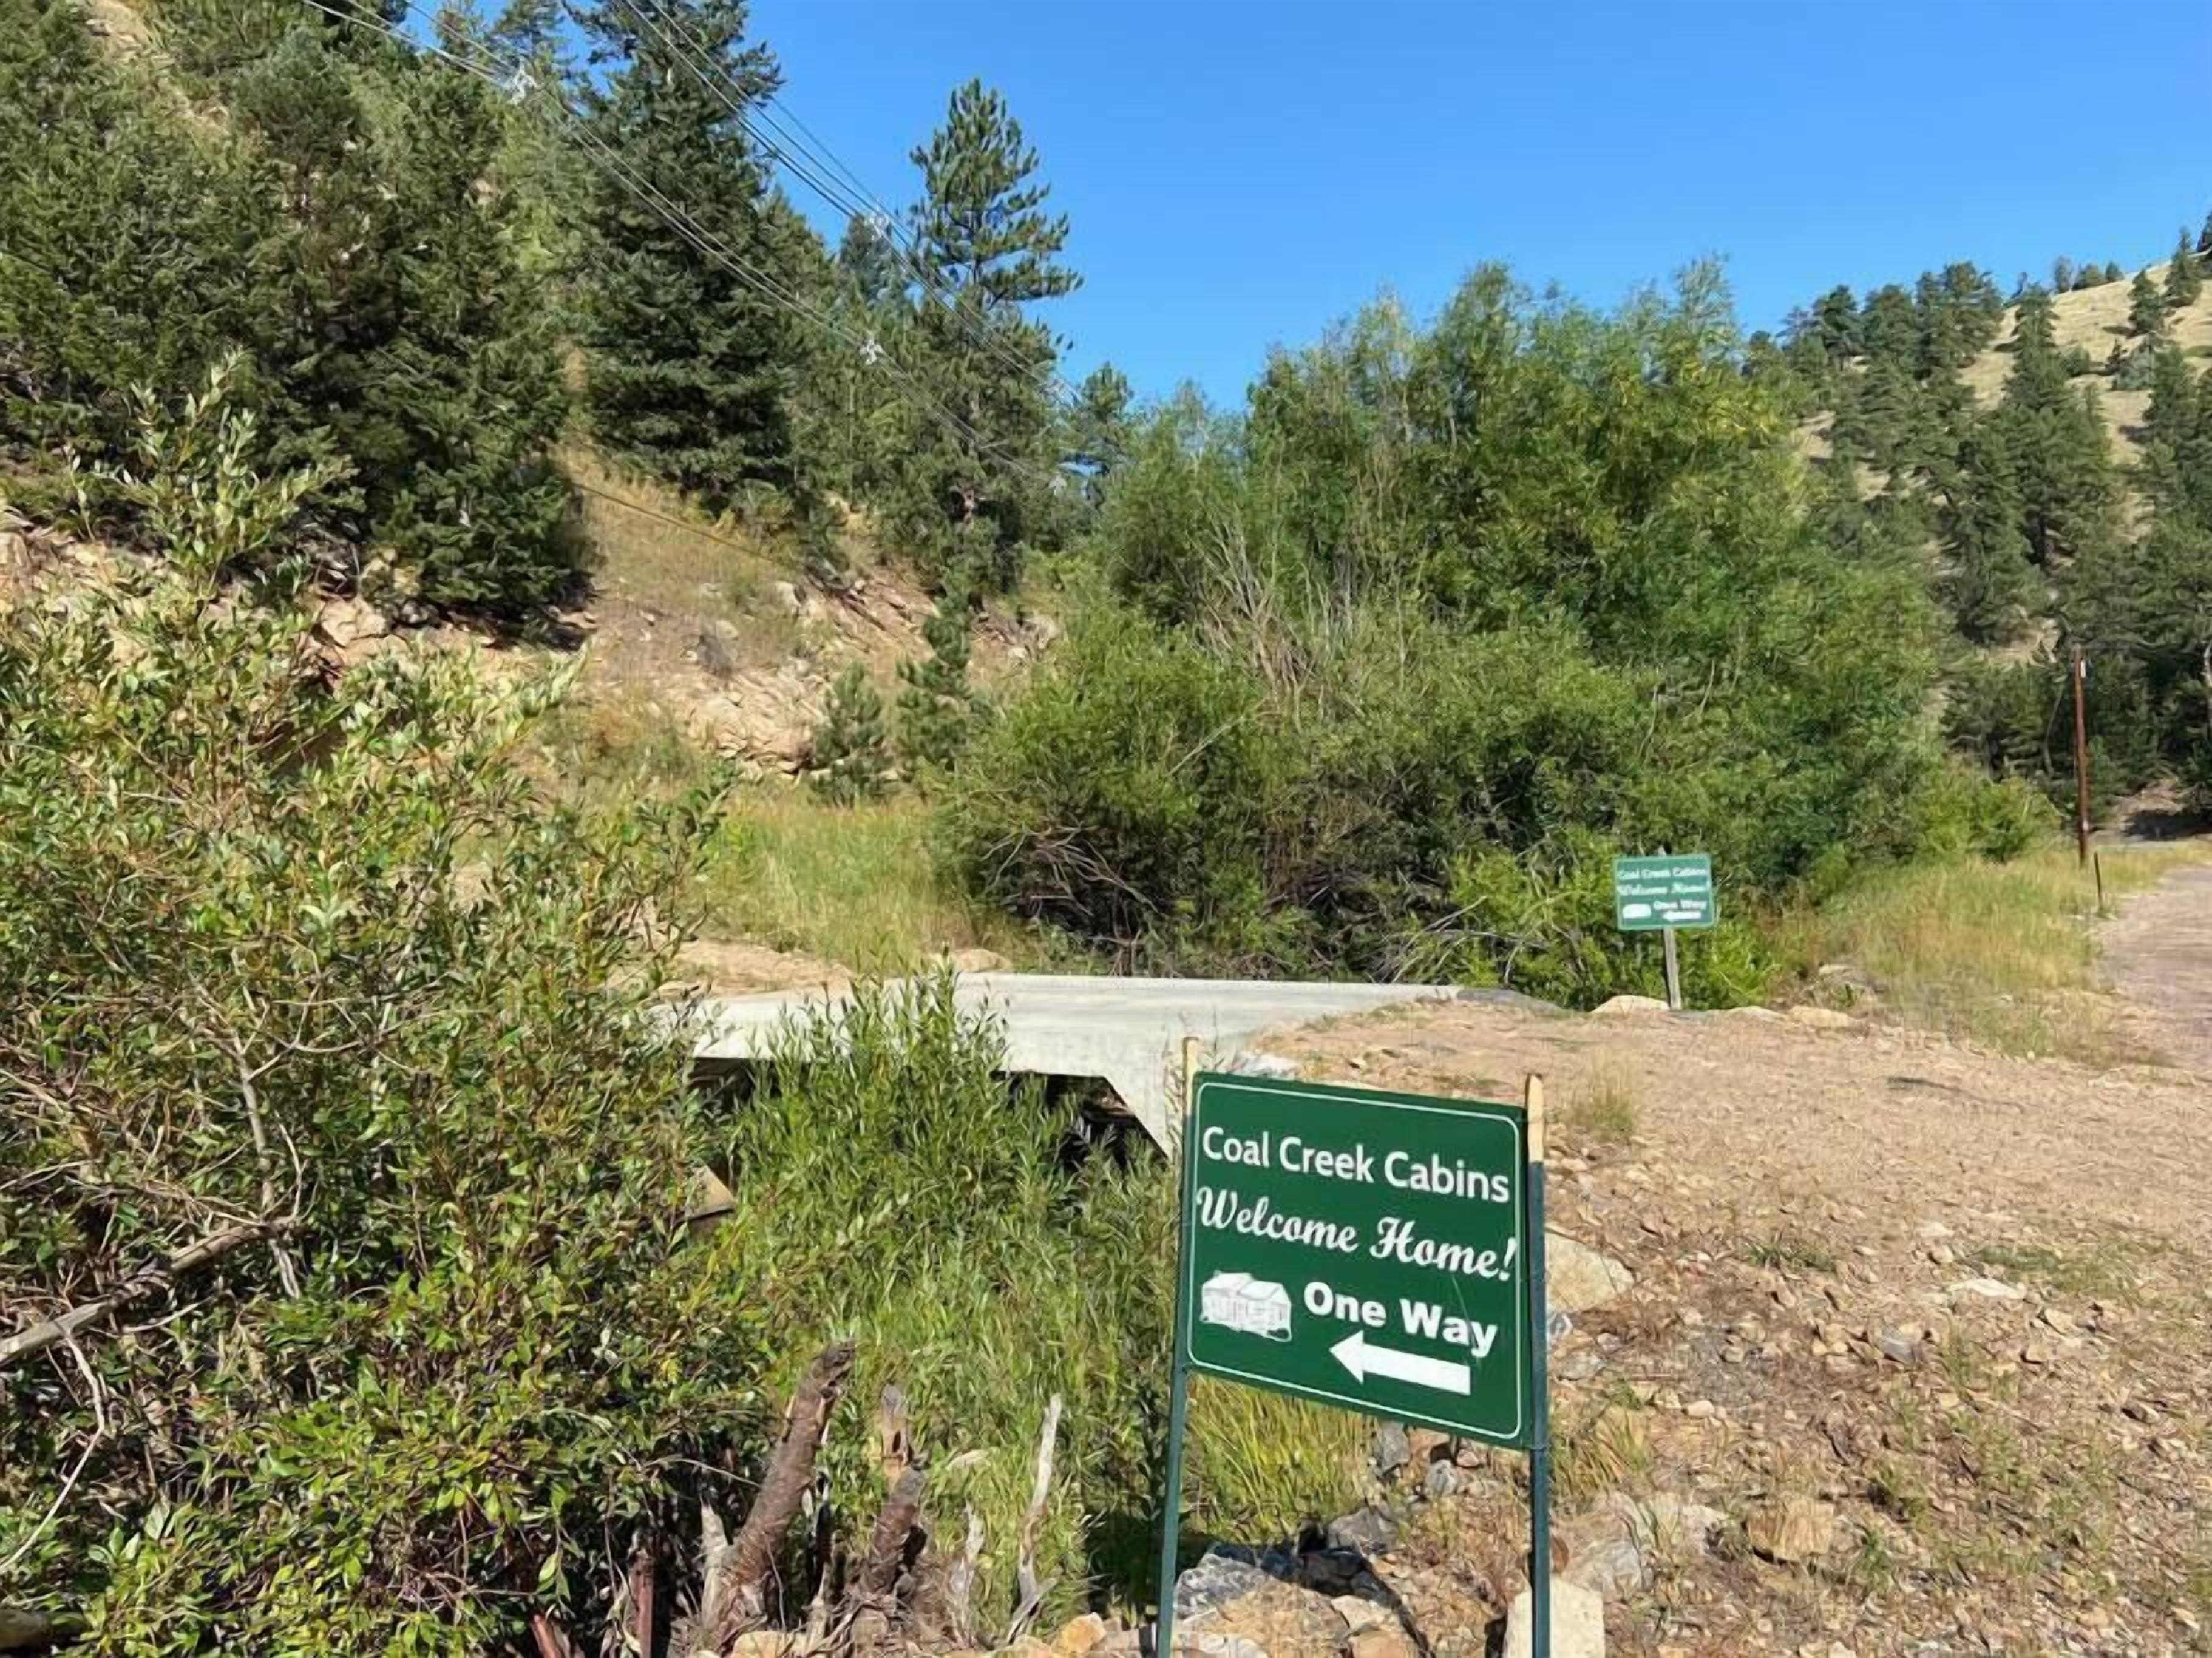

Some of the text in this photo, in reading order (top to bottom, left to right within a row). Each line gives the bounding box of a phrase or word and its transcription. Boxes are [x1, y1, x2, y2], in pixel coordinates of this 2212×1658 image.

[1202, 1127, 1510, 1203] Coal Creek Cabins
[1197, 1186, 1517, 1281] Welcome Home!
[1303, 1281, 1498, 1358] One Way
